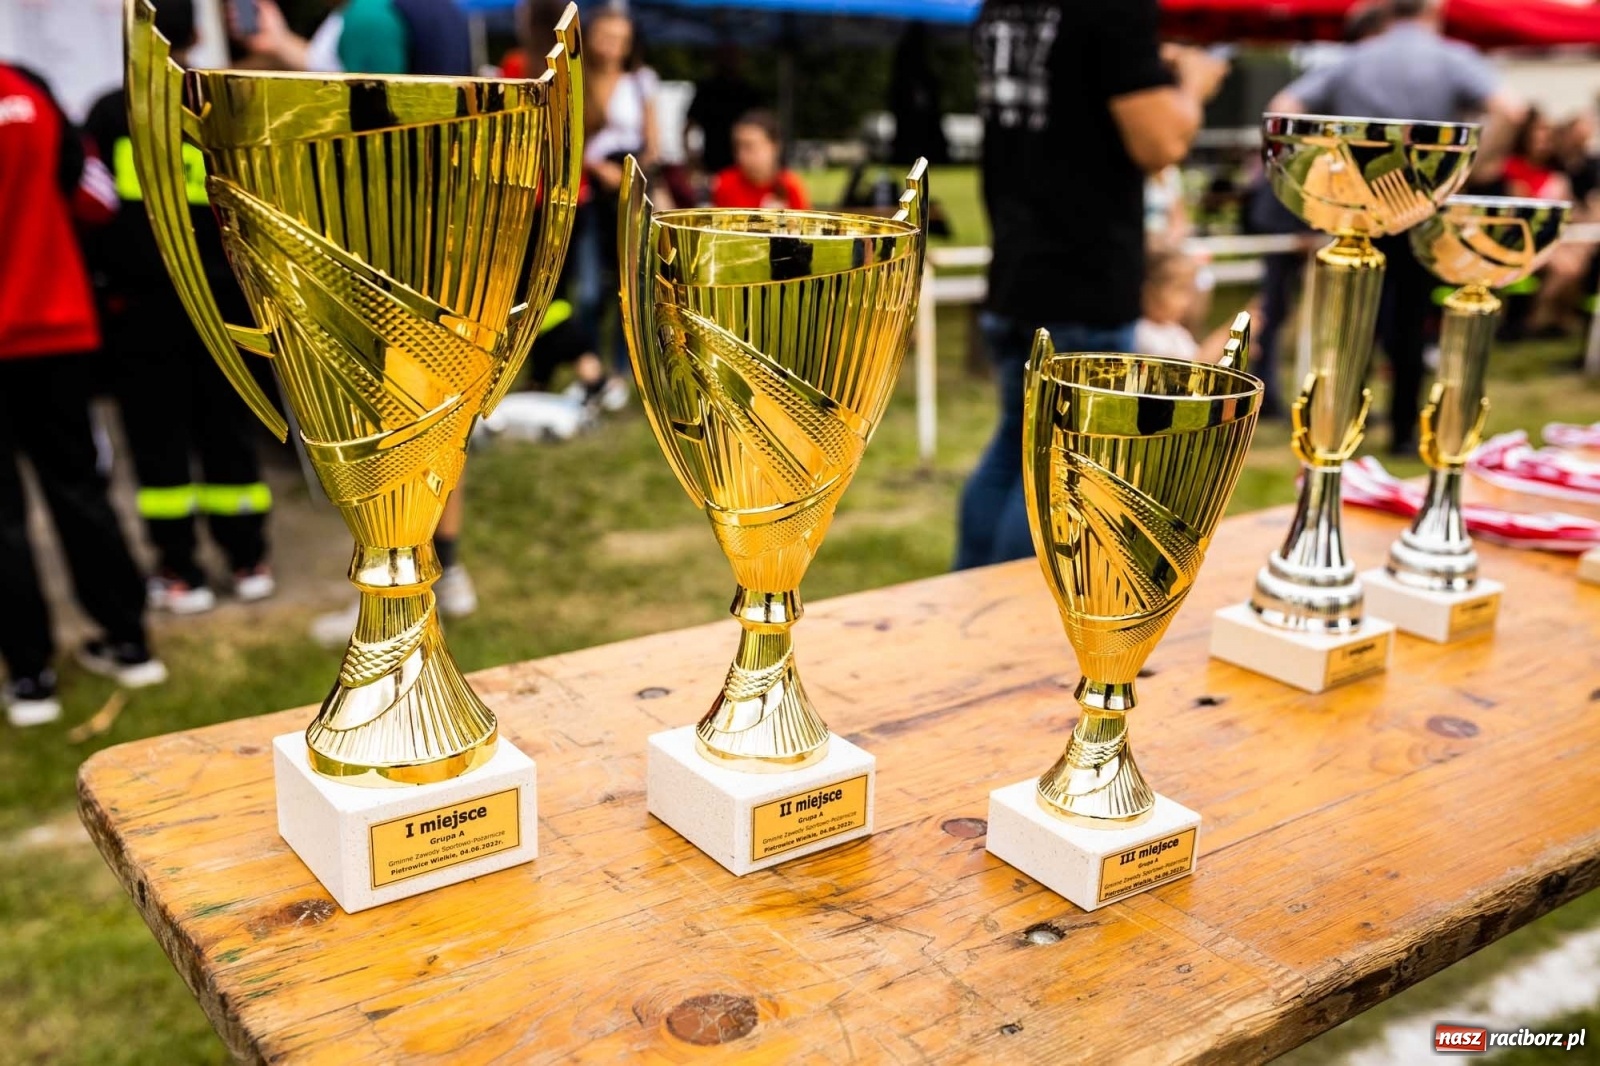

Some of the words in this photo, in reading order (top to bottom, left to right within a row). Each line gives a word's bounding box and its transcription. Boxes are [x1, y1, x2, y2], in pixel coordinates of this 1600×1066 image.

[780, 802, 792, 817] II
[796, 789, 842, 812] miejsce
[406, 823, 414, 838] I
[421, 806, 487, 834] miejsce
[798, 814, 817, 823] Grupa
[430, 833, 456, 845] Grupa
[764, 840, 794, 852] Pietrowice
[388, 855, 413, 867] Gminne
[415, 849, 440, 860] Zawody
[391, 860, 428, 875] Pietrowice
[431, 853, 458, 864] Wielkie,
[460, 840, 504, 856] 04.06.2022r.
[1120, 851, 1136, 865] III
[1139, 838, 1179, 859] miejsce
